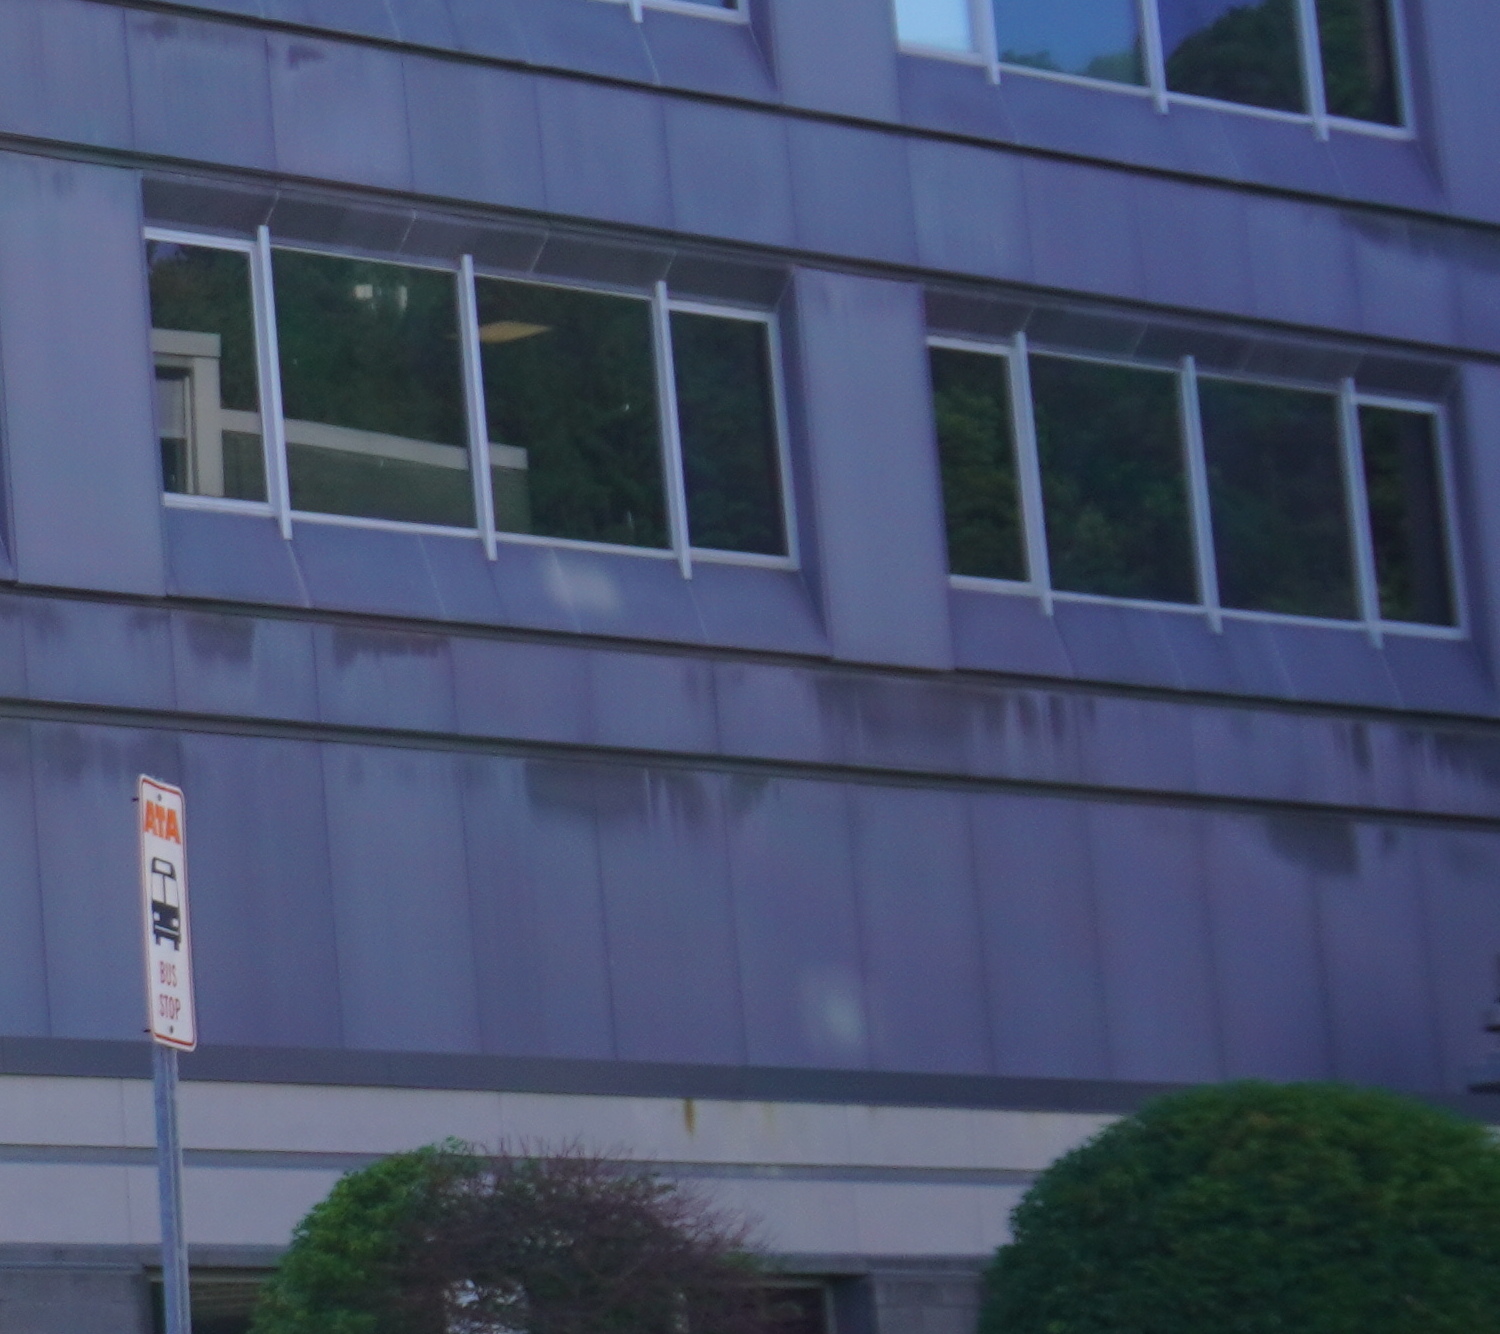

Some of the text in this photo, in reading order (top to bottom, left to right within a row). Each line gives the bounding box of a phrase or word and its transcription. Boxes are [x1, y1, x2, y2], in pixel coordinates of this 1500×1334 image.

[143, 800, 181, 845] ATA
[159, 961, 177, 987] BUS
[159, 993, 181, 1021] STOP
